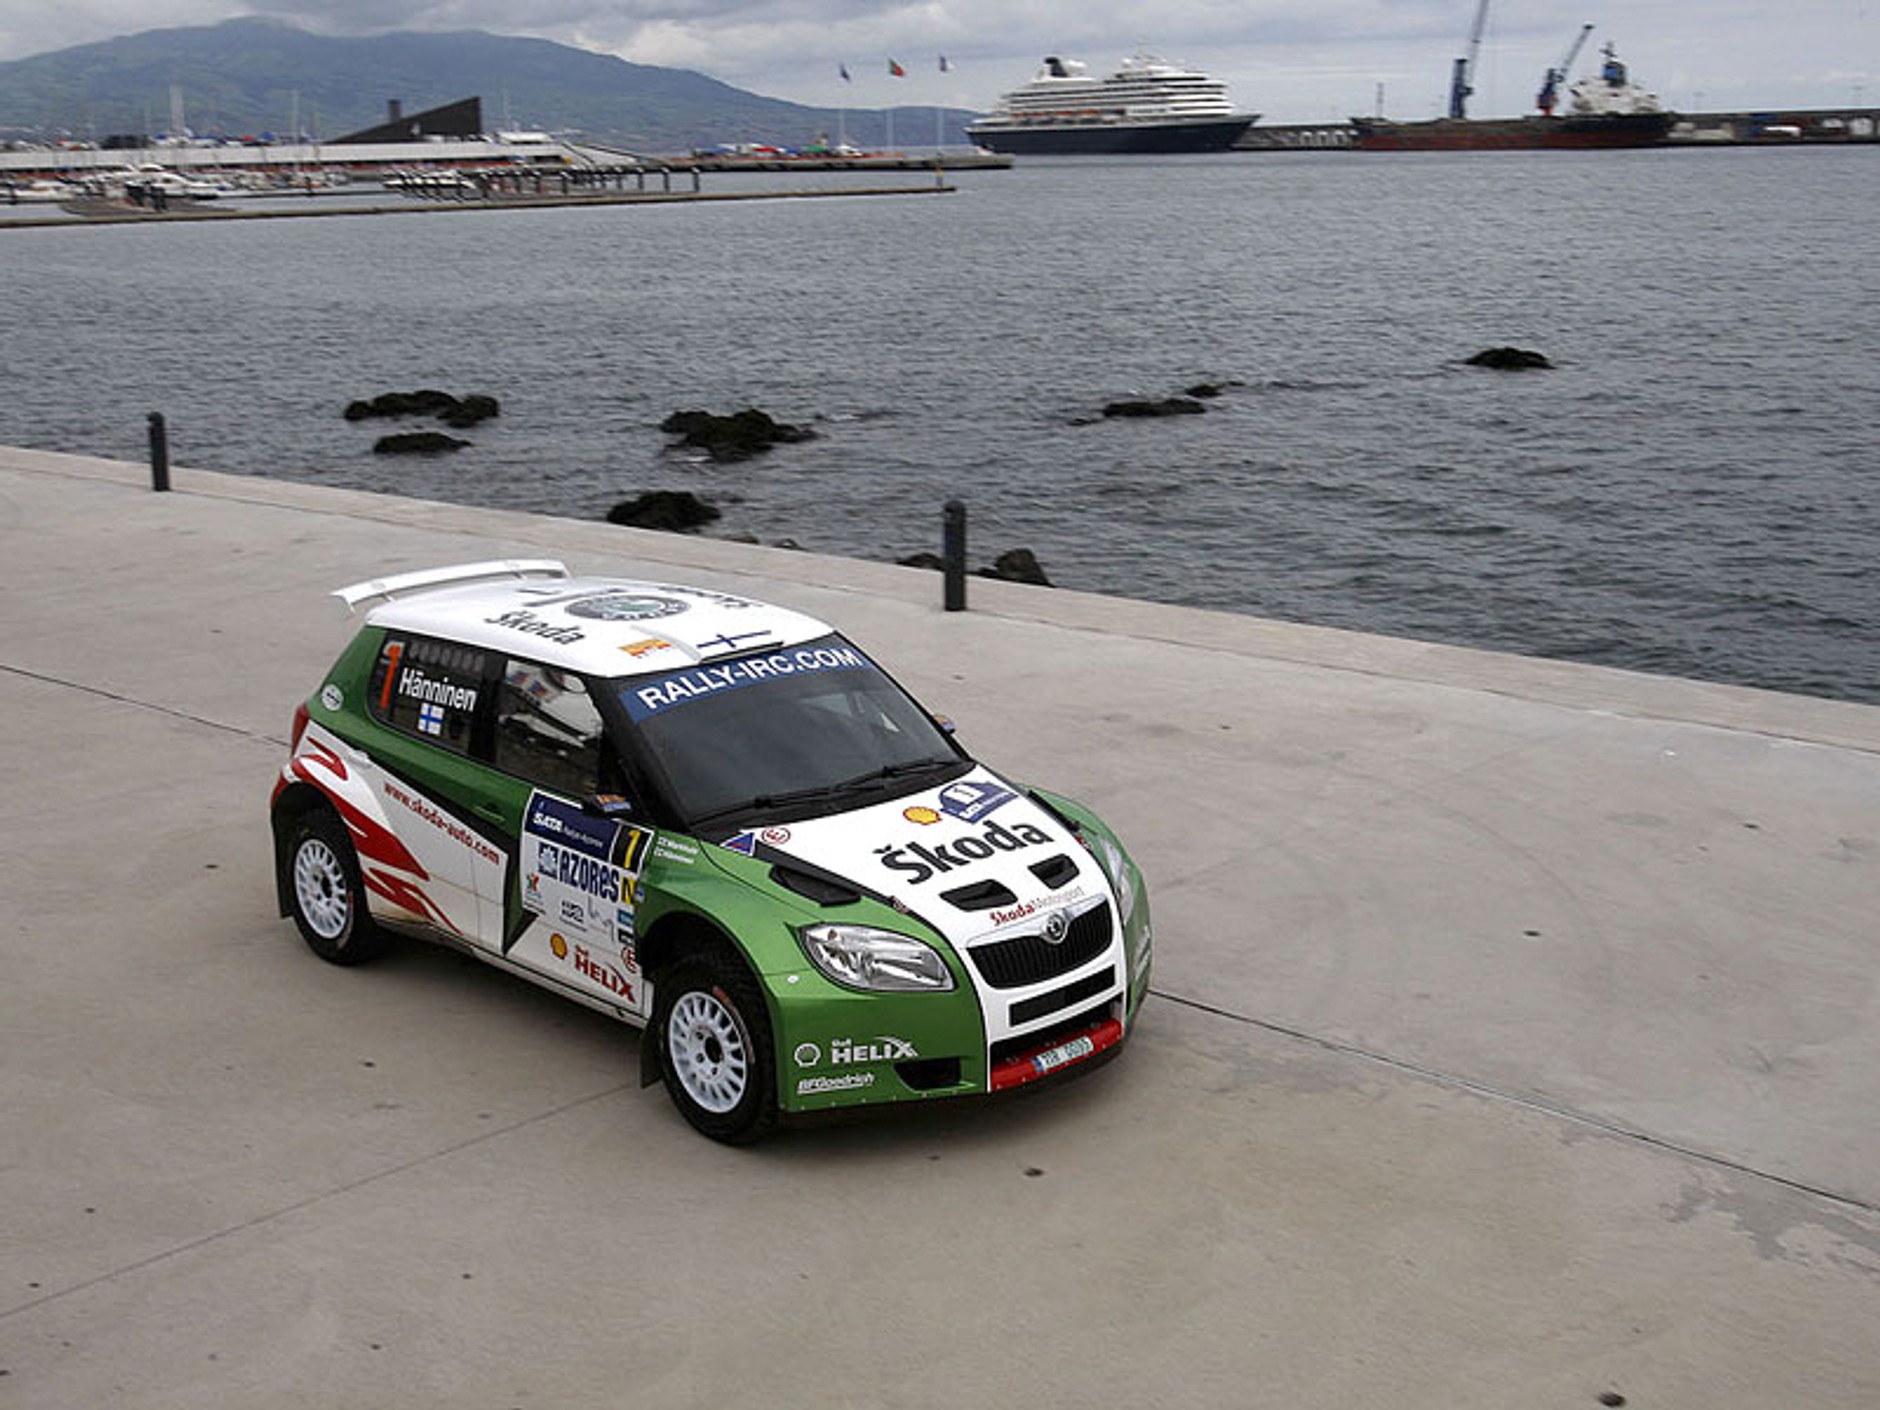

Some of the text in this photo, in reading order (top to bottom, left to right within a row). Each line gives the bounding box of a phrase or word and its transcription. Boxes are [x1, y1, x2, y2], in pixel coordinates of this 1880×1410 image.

[398, 666, 478, 712] Hänninen
[637, 646, 864, 711] RALLY-IRC.COM
[383, 781, 501, 867] www.skoda-auto.com
[532, 811, 563, 833] SATA
[623, 829, 641, 869] 1
[872, 820, 1055, 886] Škoda
[574, 952, 636, 1005] HELIX
[831, 1035, 919, 1065] HELIX
